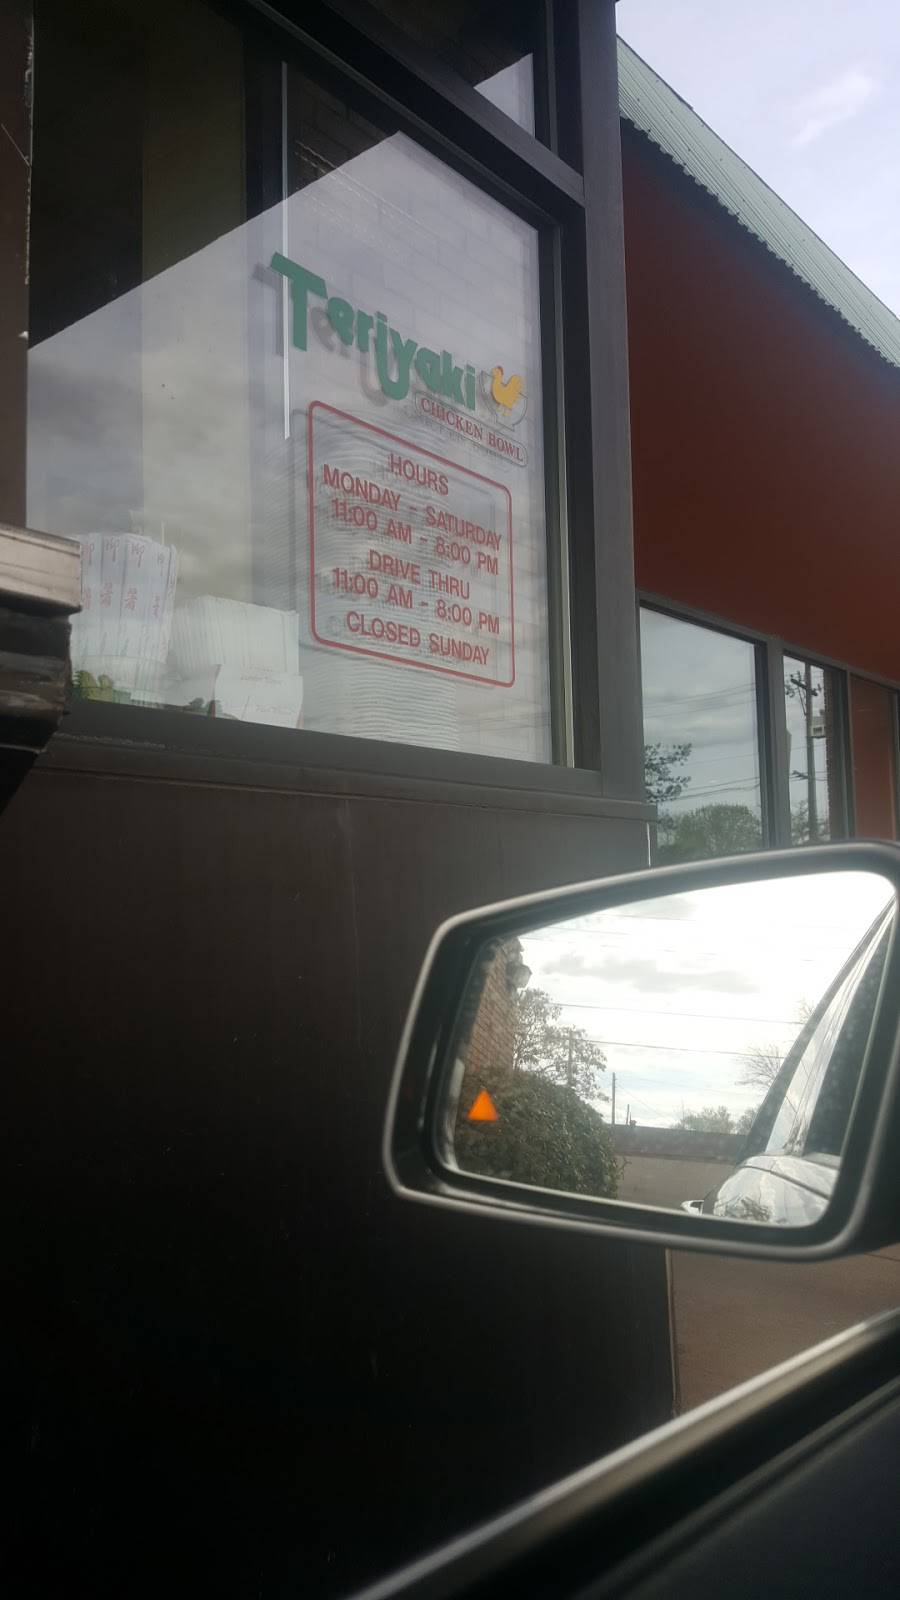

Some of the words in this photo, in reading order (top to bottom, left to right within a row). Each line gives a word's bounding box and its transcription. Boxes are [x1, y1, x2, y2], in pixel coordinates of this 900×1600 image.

[271, 252, 476, 411] Teriyaki
[421, 398, 483, 440] CHICKEN
[488, 432, 524, 462] BOWL
[323, 463, 401, 511] MONDAY
[425, 505, 502, 551] SATURDAY
[389, 453, 449, 496] HOURS
[331, 498, 378, 531] 11:00
[386, 518, 412, 545] AM
[435, 536, 471, 565] 8:00
[477, 551, 499, 576] PM
[332, 567, 379, 599] 11:00
[386, 584, 413, 609] AM
[436, 599, 472, 626] 8:00
[479, 611, 500, 635] PM
[368, 549, 421, 585] DRIVE
[428, 569, 470, 600] THRU
[346, 610, 421, 648] CLOSED
[429, 632, 489, 665] SUNDAY
